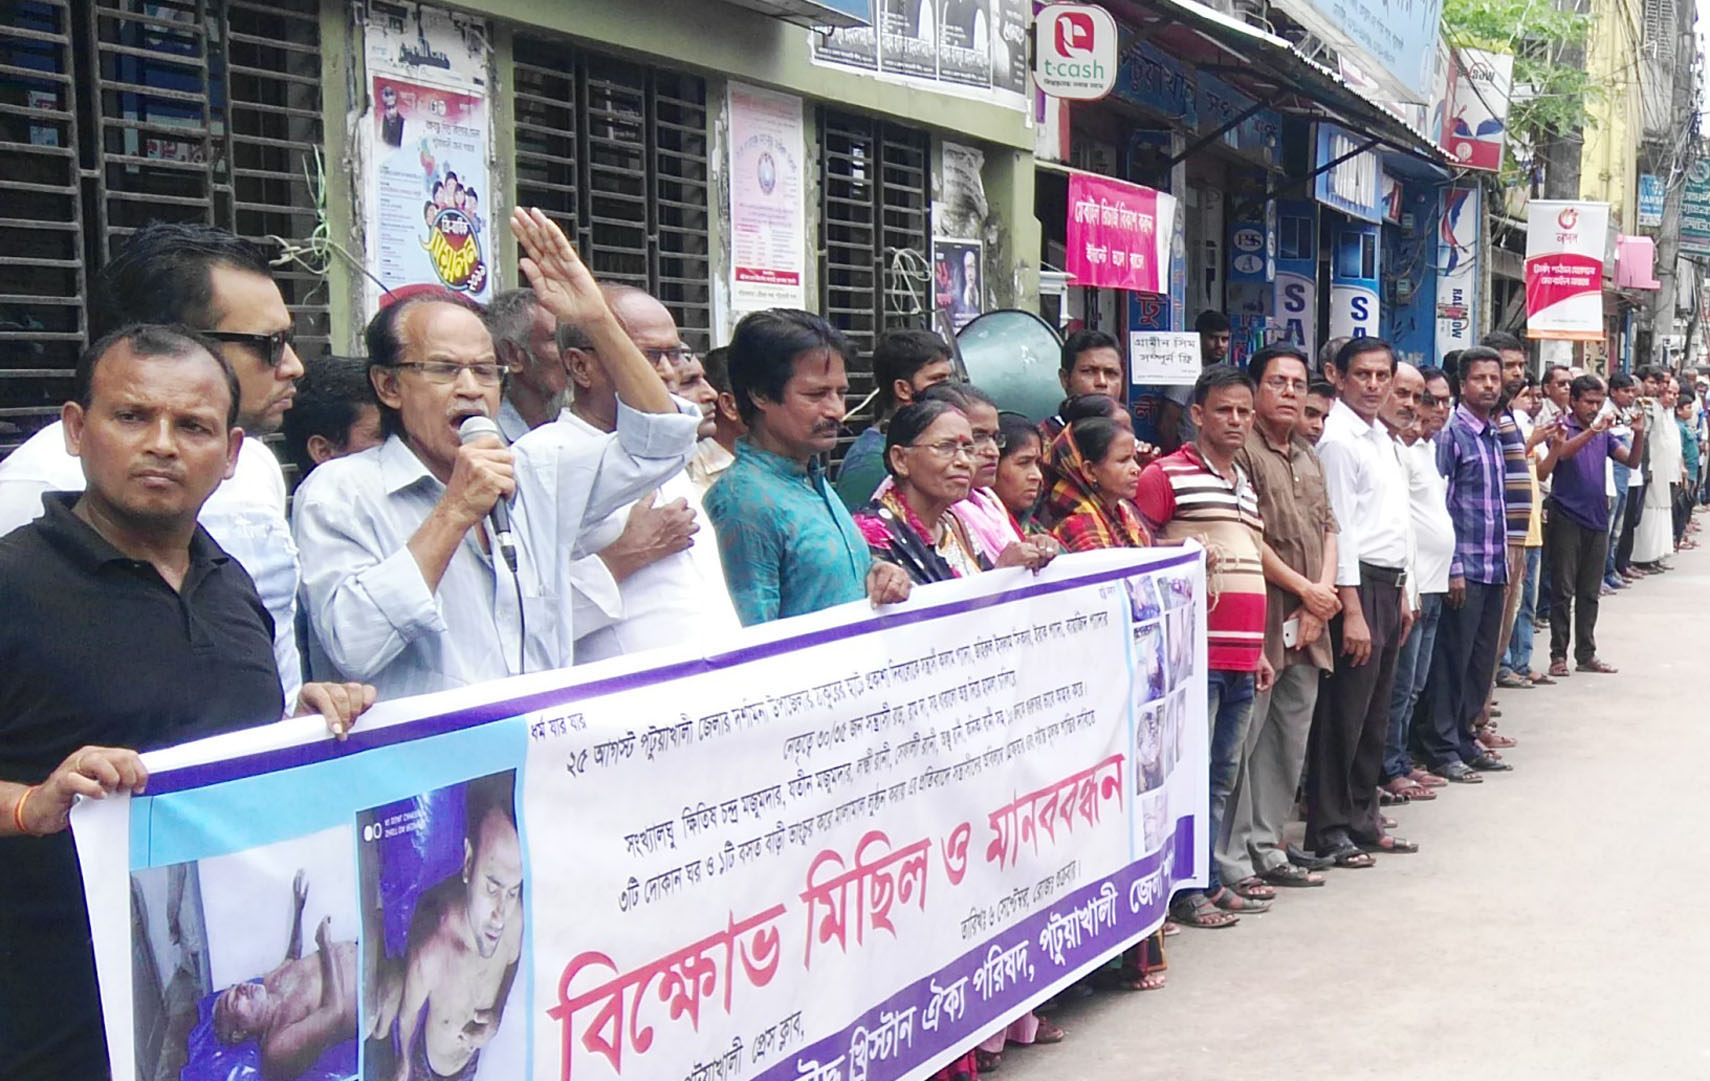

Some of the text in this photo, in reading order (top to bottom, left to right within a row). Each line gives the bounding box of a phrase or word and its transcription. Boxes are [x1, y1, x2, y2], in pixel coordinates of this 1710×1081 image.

[567, 749, 588, 778] ২৫
[594, 731, 637, 768] আগস্ট
[640, 713, 694, 763] পটুয়াখালী
[698, 711, 731, 743] জেলার
[623, 820, 677, 859] সংখ্যালঘু
[719, 799, 739, 824] চন্দ্র
[800, 828, 932, 973] মিছিল
[941, 822, 972, 886] ও
[985, 753, 1126, 872] মানববন্ধন
[618, 876, 640, 912] ৩টি
[644, 867, 683, 904] দোকান
[685, 860, 702, 883] ঘর
[706, 856, 714, 876] ও
[718, 840, 736, 875] ১টি
[737, 836, 763, 864] বসত
[922, 968, 969, 1033] ঐক্য
[972, 939, 1037, 1012] পরিষদ,
[1038, 881, 1119, 967] পটুয়াখালী
[1129, 869, 1164, 914] জেলা
[751, 1025, 777, 1065] প্রেস
